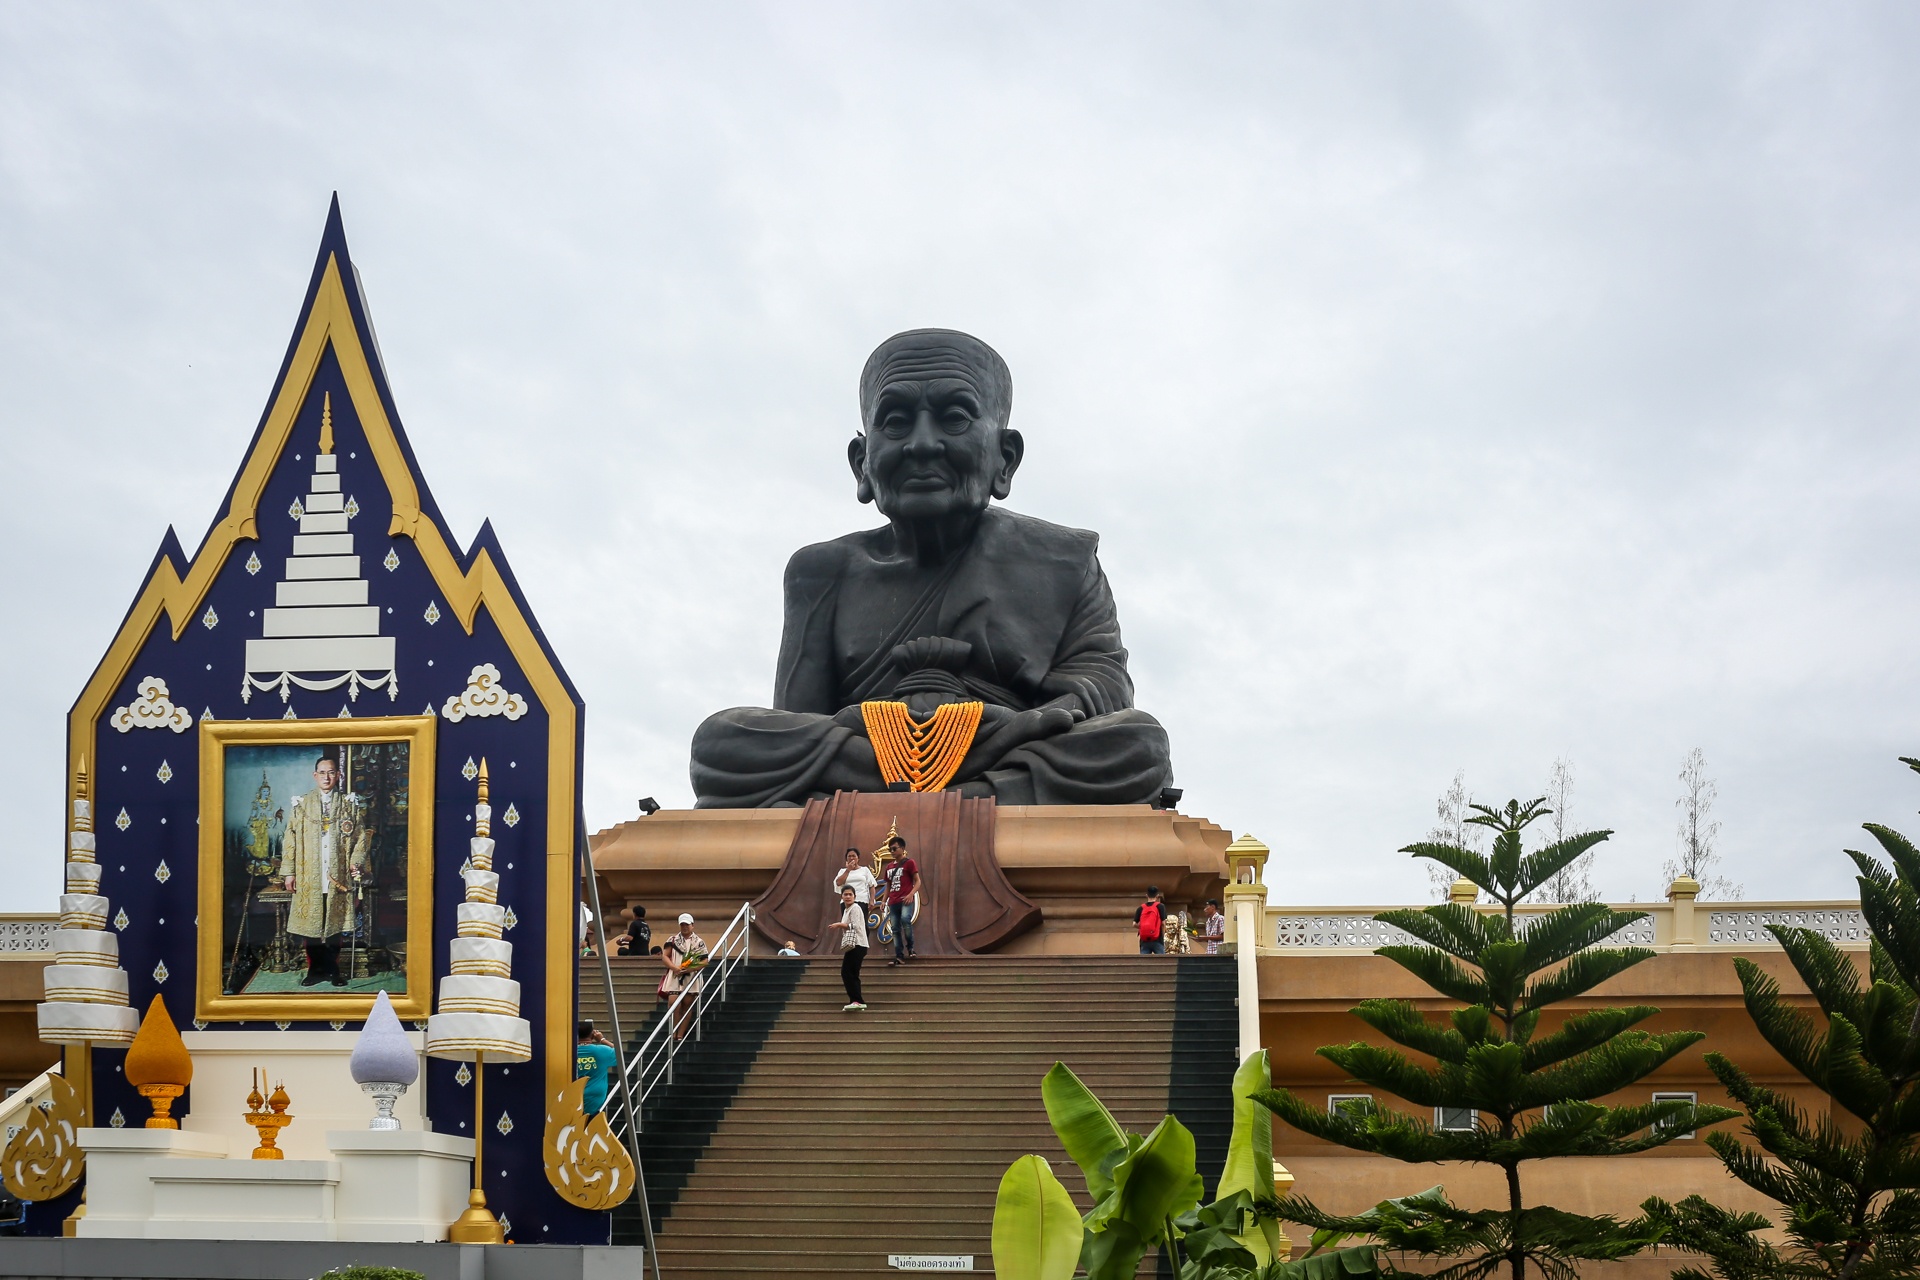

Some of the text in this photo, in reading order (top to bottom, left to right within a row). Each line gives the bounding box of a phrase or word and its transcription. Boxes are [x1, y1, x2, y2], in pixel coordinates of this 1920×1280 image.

[894, 1256, 966, 1268] ไม่ต้องถอดรองเท้า
